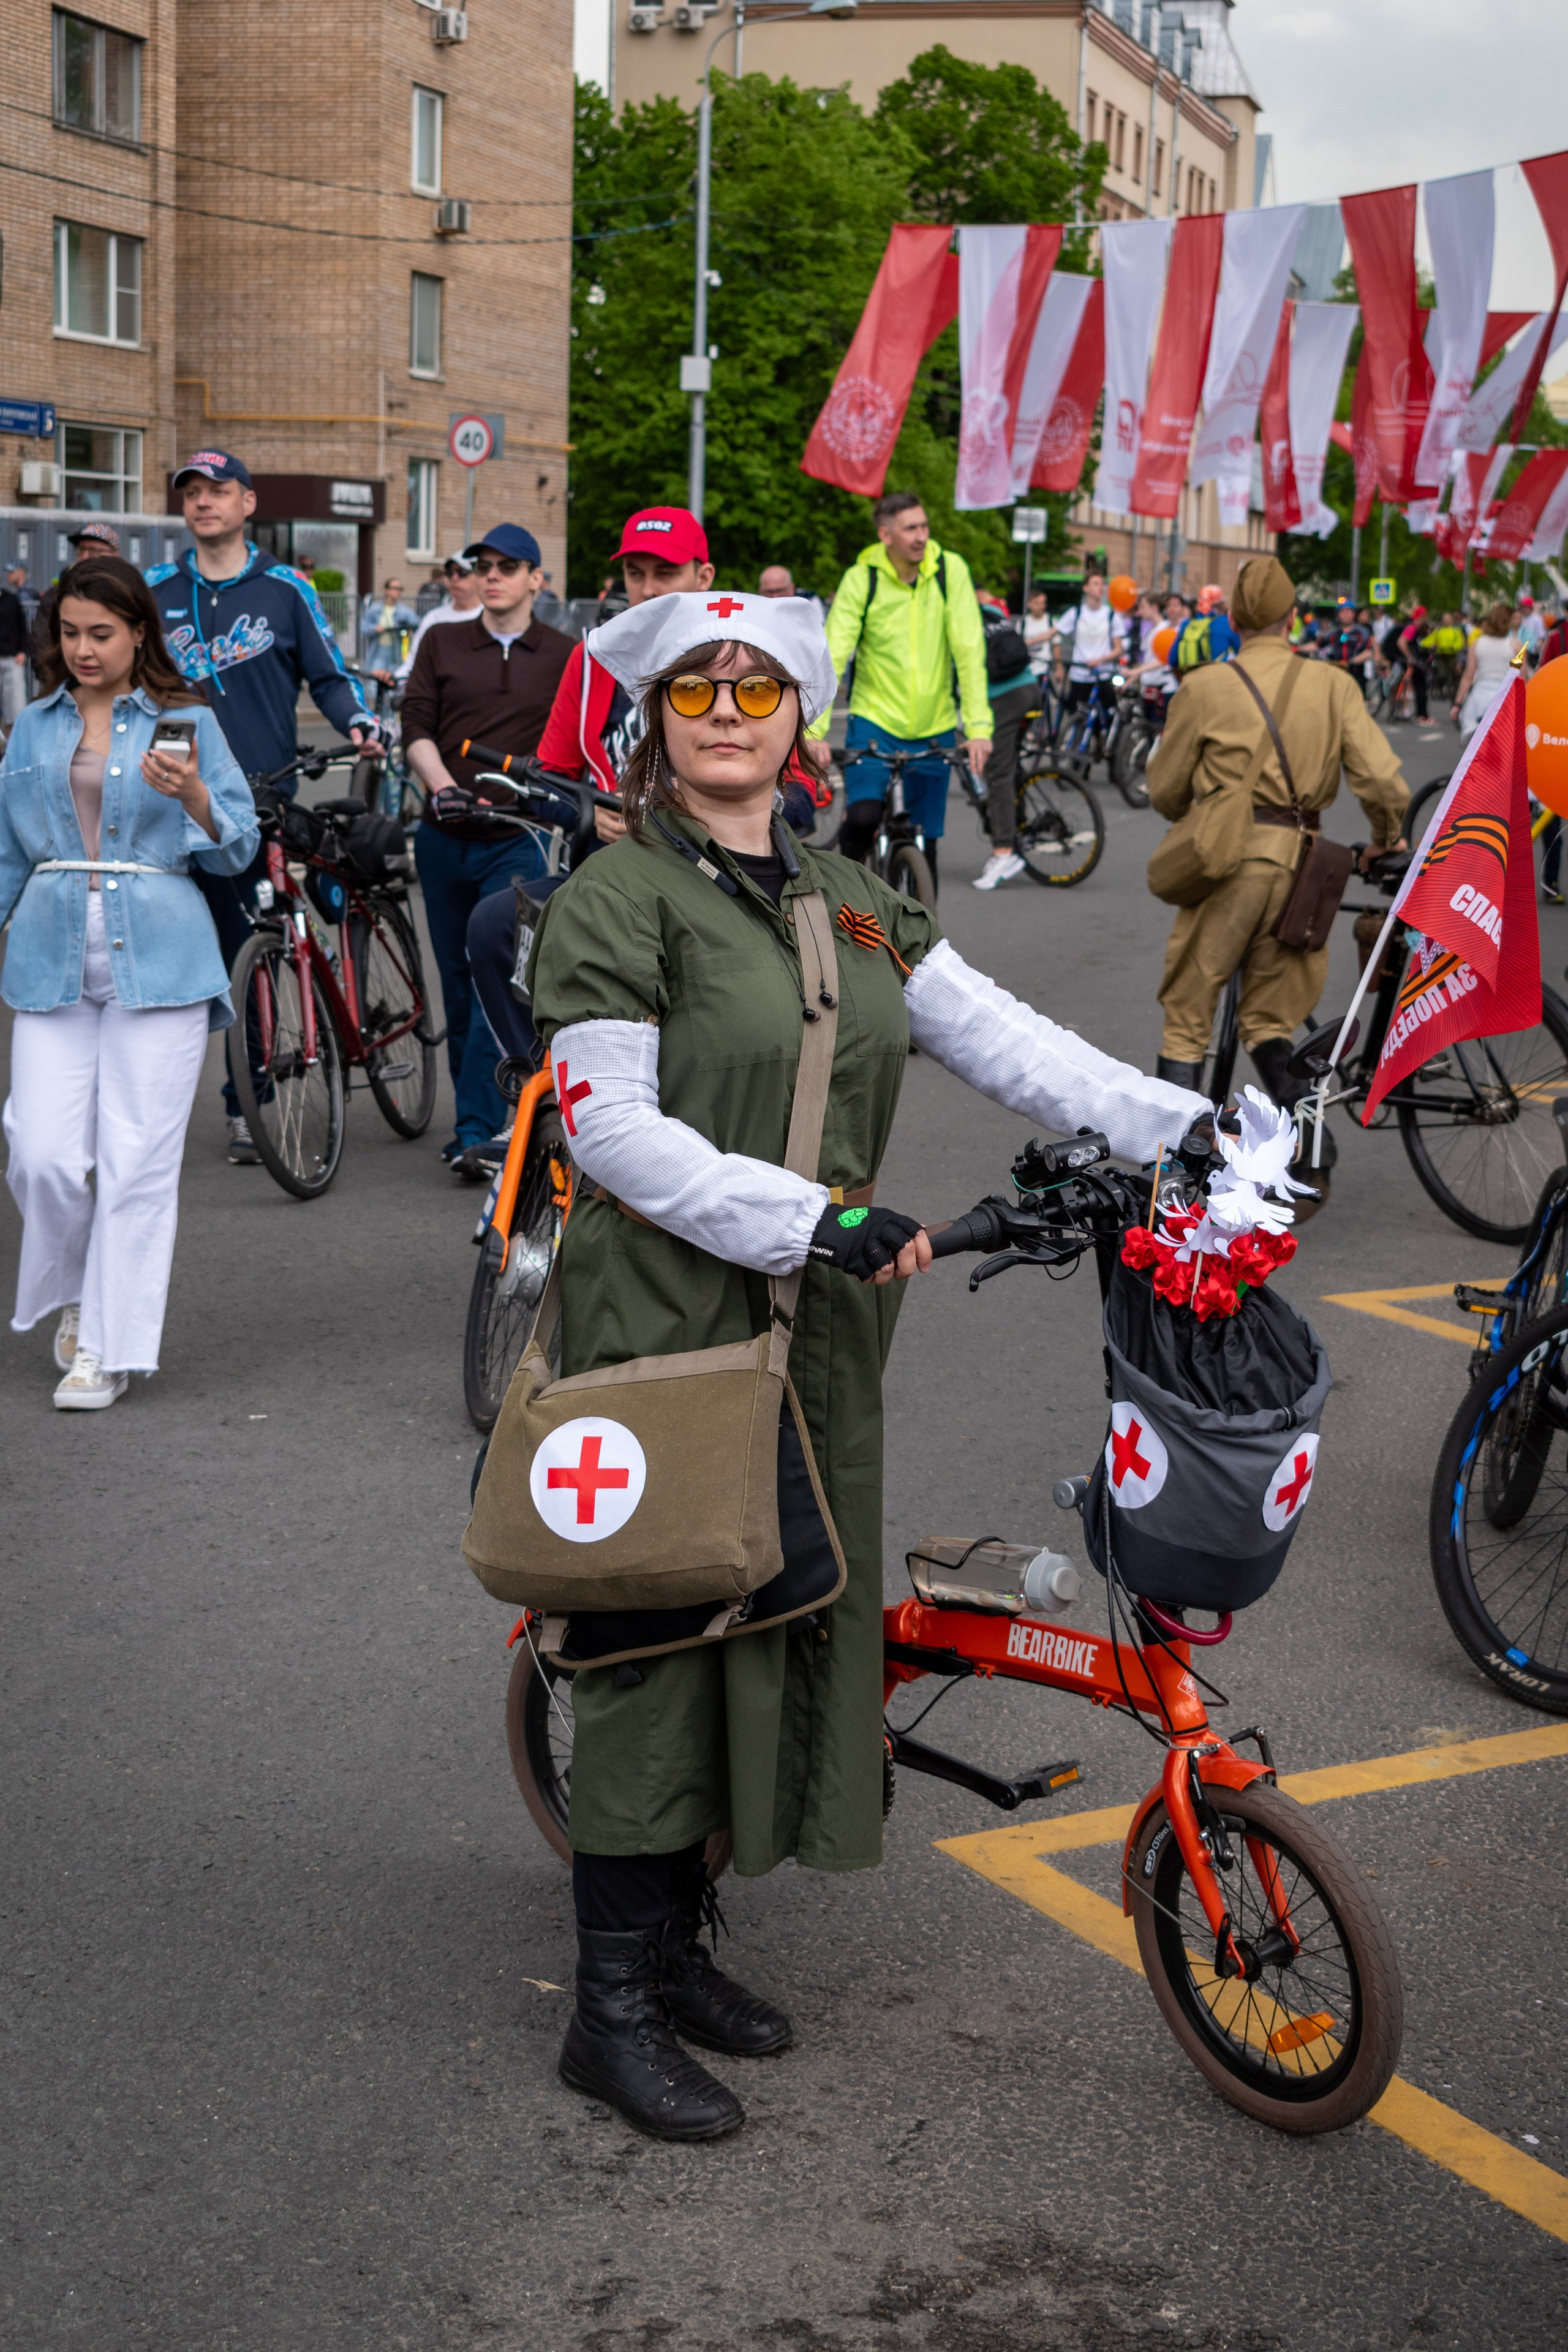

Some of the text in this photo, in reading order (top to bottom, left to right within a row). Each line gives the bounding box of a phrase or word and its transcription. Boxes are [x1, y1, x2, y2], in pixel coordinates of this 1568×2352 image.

[459, 431, 483, 452] 40
[1449, 884, 1502, 952] СПАС
[1006, 1623, 1099, 1678] BEARBIKE
[1191, 1773, 1202, 1800] PROMAX
